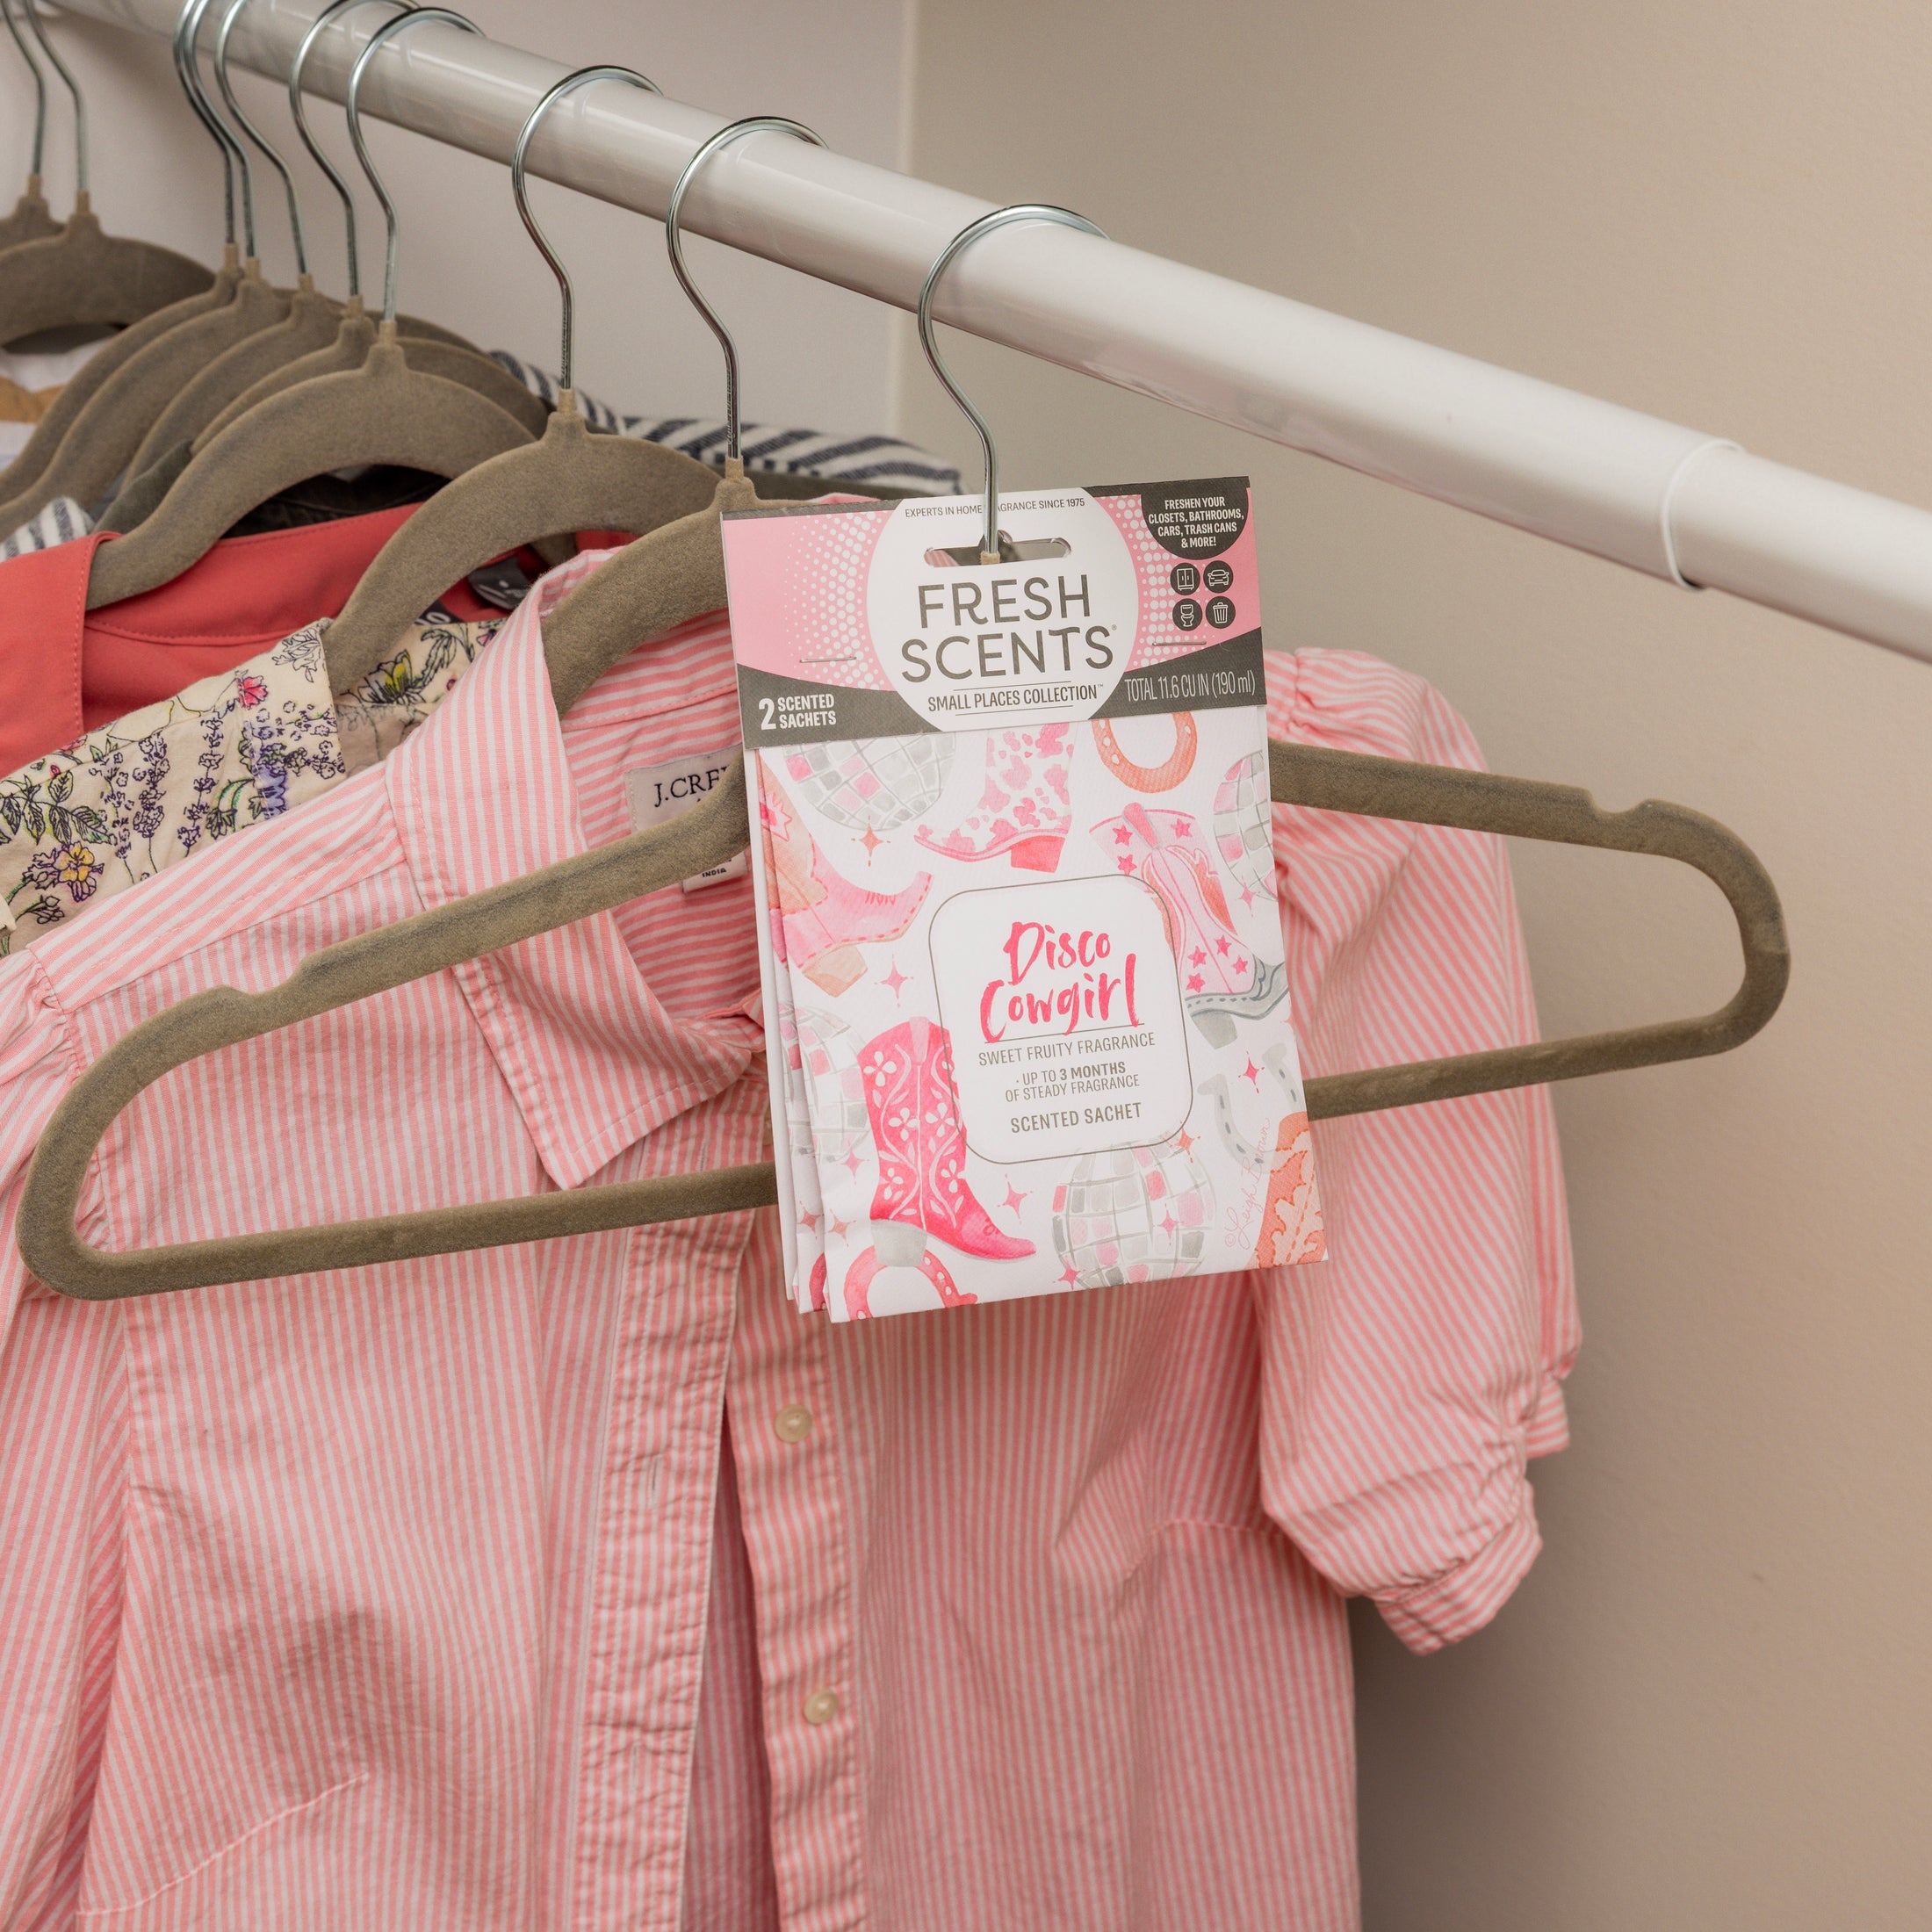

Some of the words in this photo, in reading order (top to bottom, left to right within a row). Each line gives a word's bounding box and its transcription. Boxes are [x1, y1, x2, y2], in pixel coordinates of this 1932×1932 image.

[905, 506, 943, 517] EXPERTS
[945, 505, 955, 515] IN
[956, 504, 983, 515] HOME
[996, 501, 1037, 513] GRANCE
[1038, 499, 1065, 509] SINCE
[1066, 498, 1085, 508] 1975
[1148, 511, 1188, 524] CLOSETS,
[1188, 508, 1244, 522] BATHROOMS,
[1164, 498, 1201, 510] FRESHEN
[1201, 496, 1226, 508] YOUR
[1157, 525, 1184, 537] CARS,
[1184, 523, 1213, 535] TRASH
[1214, 522, 1237, 533] CANS
[1181, 537, 1189, 548] &
[1189, 536, 1216, 548] MORE!
[918, 573, 1091, 629] FRESH
[1124, 677, 1157, 702] TOTAL
[1157, 674, 1179, 699] 11.6
[1180, 674, 1196, 698] CU
[1197, 673, 1209, 696] IN
[1211, 671, 1236, 699] (190
[1237, 669, 1256, 696] ml)
[758, 697, 777, 731] 2
[777, 693, 835, 712] SCENTED
[927, 694, 971, 712] SMALL
[974, 689, 1020, 709] PLACES
[779, 710, 837, 729] SACHETS
[653, 764, 728, 808] J.CRE
[702, 868, 727, 877] INDIA
[1002, 921, 1111, 986] Disco
[980, 953, 1140, 1043] Cowgirl
[978, 1048, 1022, 1066] SWEET
[1027, 1042, 1074, 1061] FRUITY
[1077, 1032, 1156, 1055] FRAGRANCE
[1022, 1071, 1038, 1085] UP
[1041, 1070, 1056, 1083] TO
[1060, 1068, 1068, 1081] 3
[1071, 1061, 1127, 1080] MONTHS
[1005, 1088, 1020, 1102] OF
[1023, 1084, 1067, 1100] STEADY
[1071, 1073, 1140, 1094] FRAGRANCE
[1011, 1110, 1079, 1134] SCENTED
[1084, 1102, 1142, 1124] SACHET
